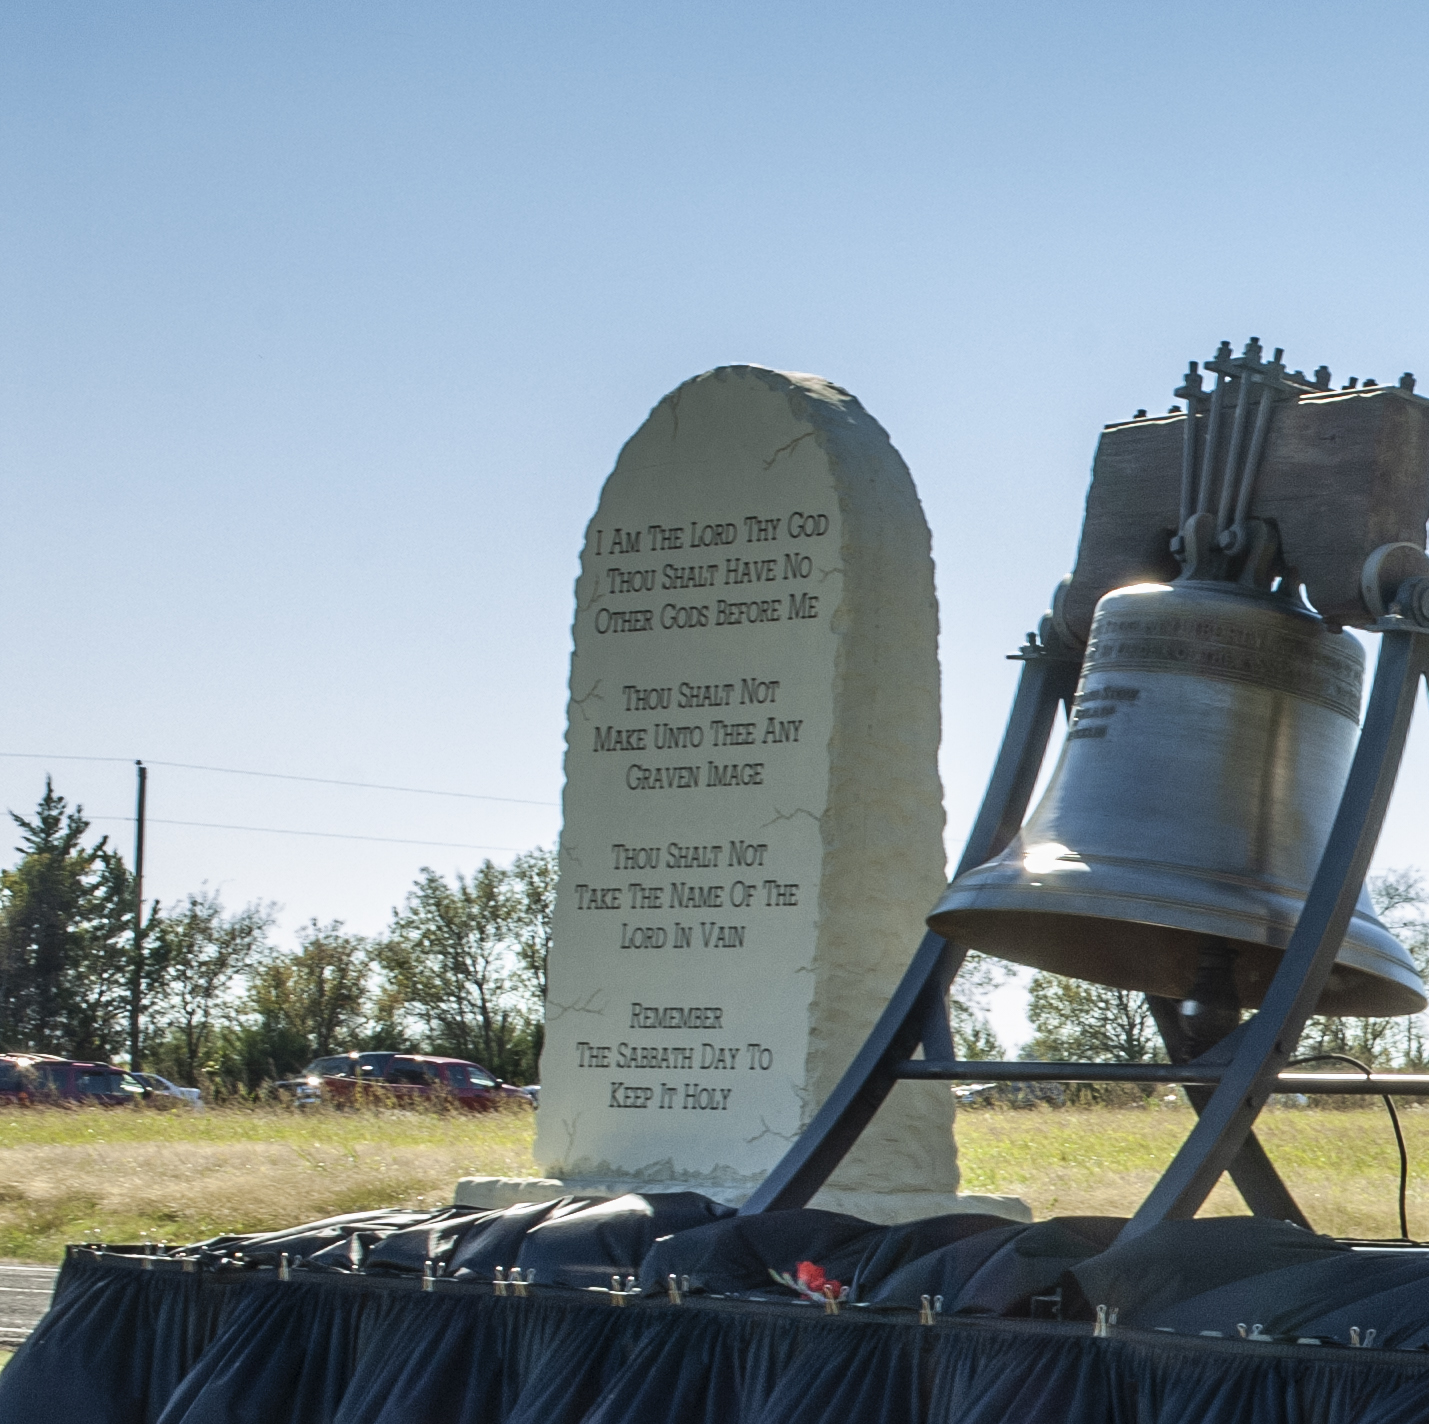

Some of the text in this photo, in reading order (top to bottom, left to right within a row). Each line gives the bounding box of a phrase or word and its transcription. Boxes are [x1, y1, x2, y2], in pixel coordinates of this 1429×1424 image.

[595, 512, 828, 556] I AM THE LORD THY GOD
[607, 553, 812, 594] THOU SHALT HAVE NO
[596, 593, 818, 634] OTHER GODS BEFORE ME
[623, 678, 780, 711] THOU SHALT NOT
[593, 717, 803, 752] MAKE UNTO THEE ANY
[627, 761, 764, 790] GRAVEN IMAGE
[612, 840, 768, 870] THOU SHALT NOT
[576, 880, 799, 910] TAKE THE NAME OF THE
[620, 922, 745, 949] LORD IN VAIN
[630, 1003, 722, 1029] REMEMBER
[577, 1042, 772, 1070] THE SABBATH DAY TO
[609, 1082, 732, 1110] KEEP IT HOLY
